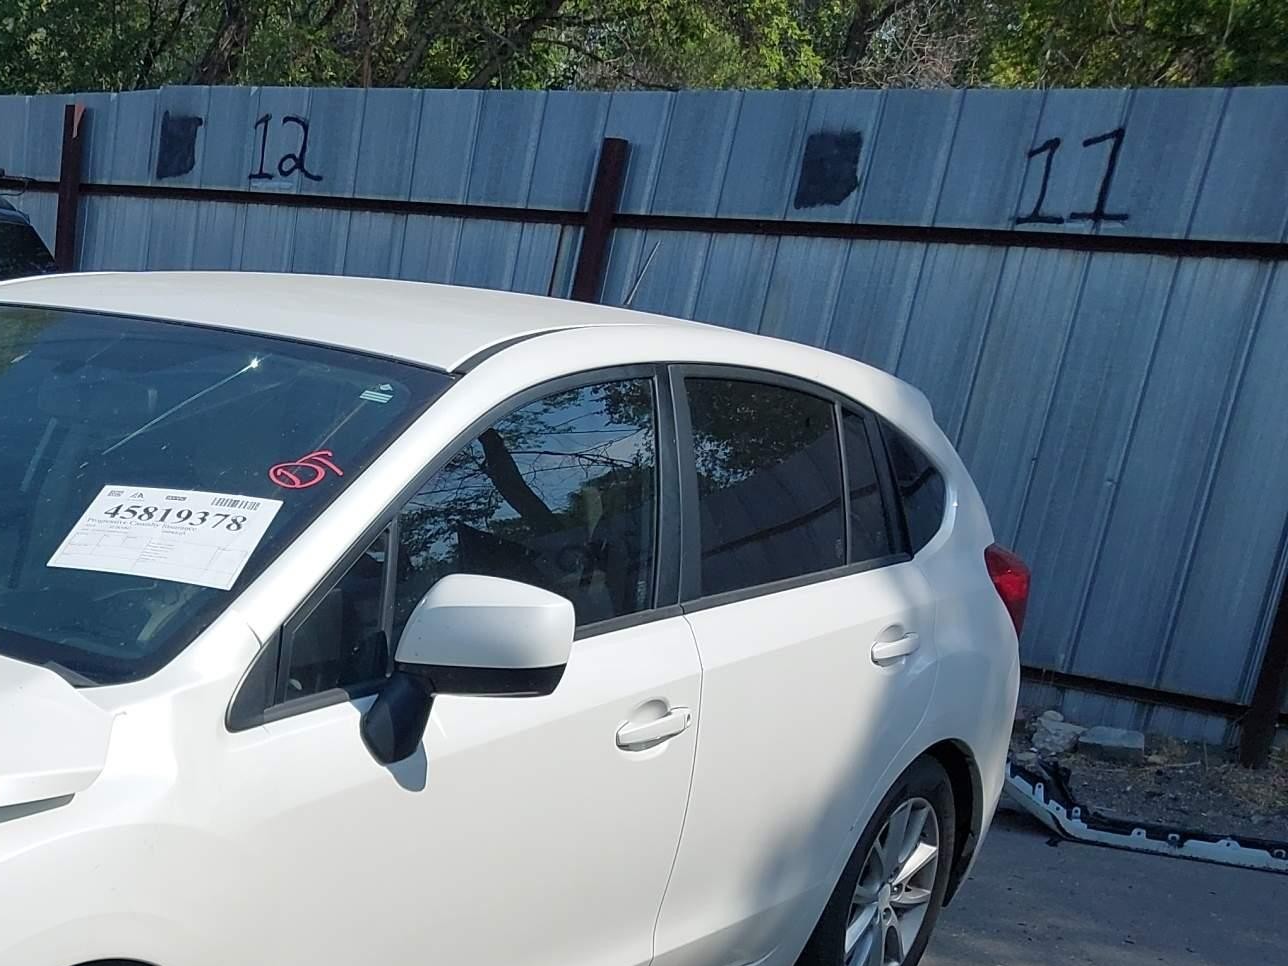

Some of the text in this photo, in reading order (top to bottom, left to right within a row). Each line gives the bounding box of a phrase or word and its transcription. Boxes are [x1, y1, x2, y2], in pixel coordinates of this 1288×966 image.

[248, 113, 323, 181] 12
[1015, 128, 1129, 225] 11
[104, 503, 247, 532] 45819378
